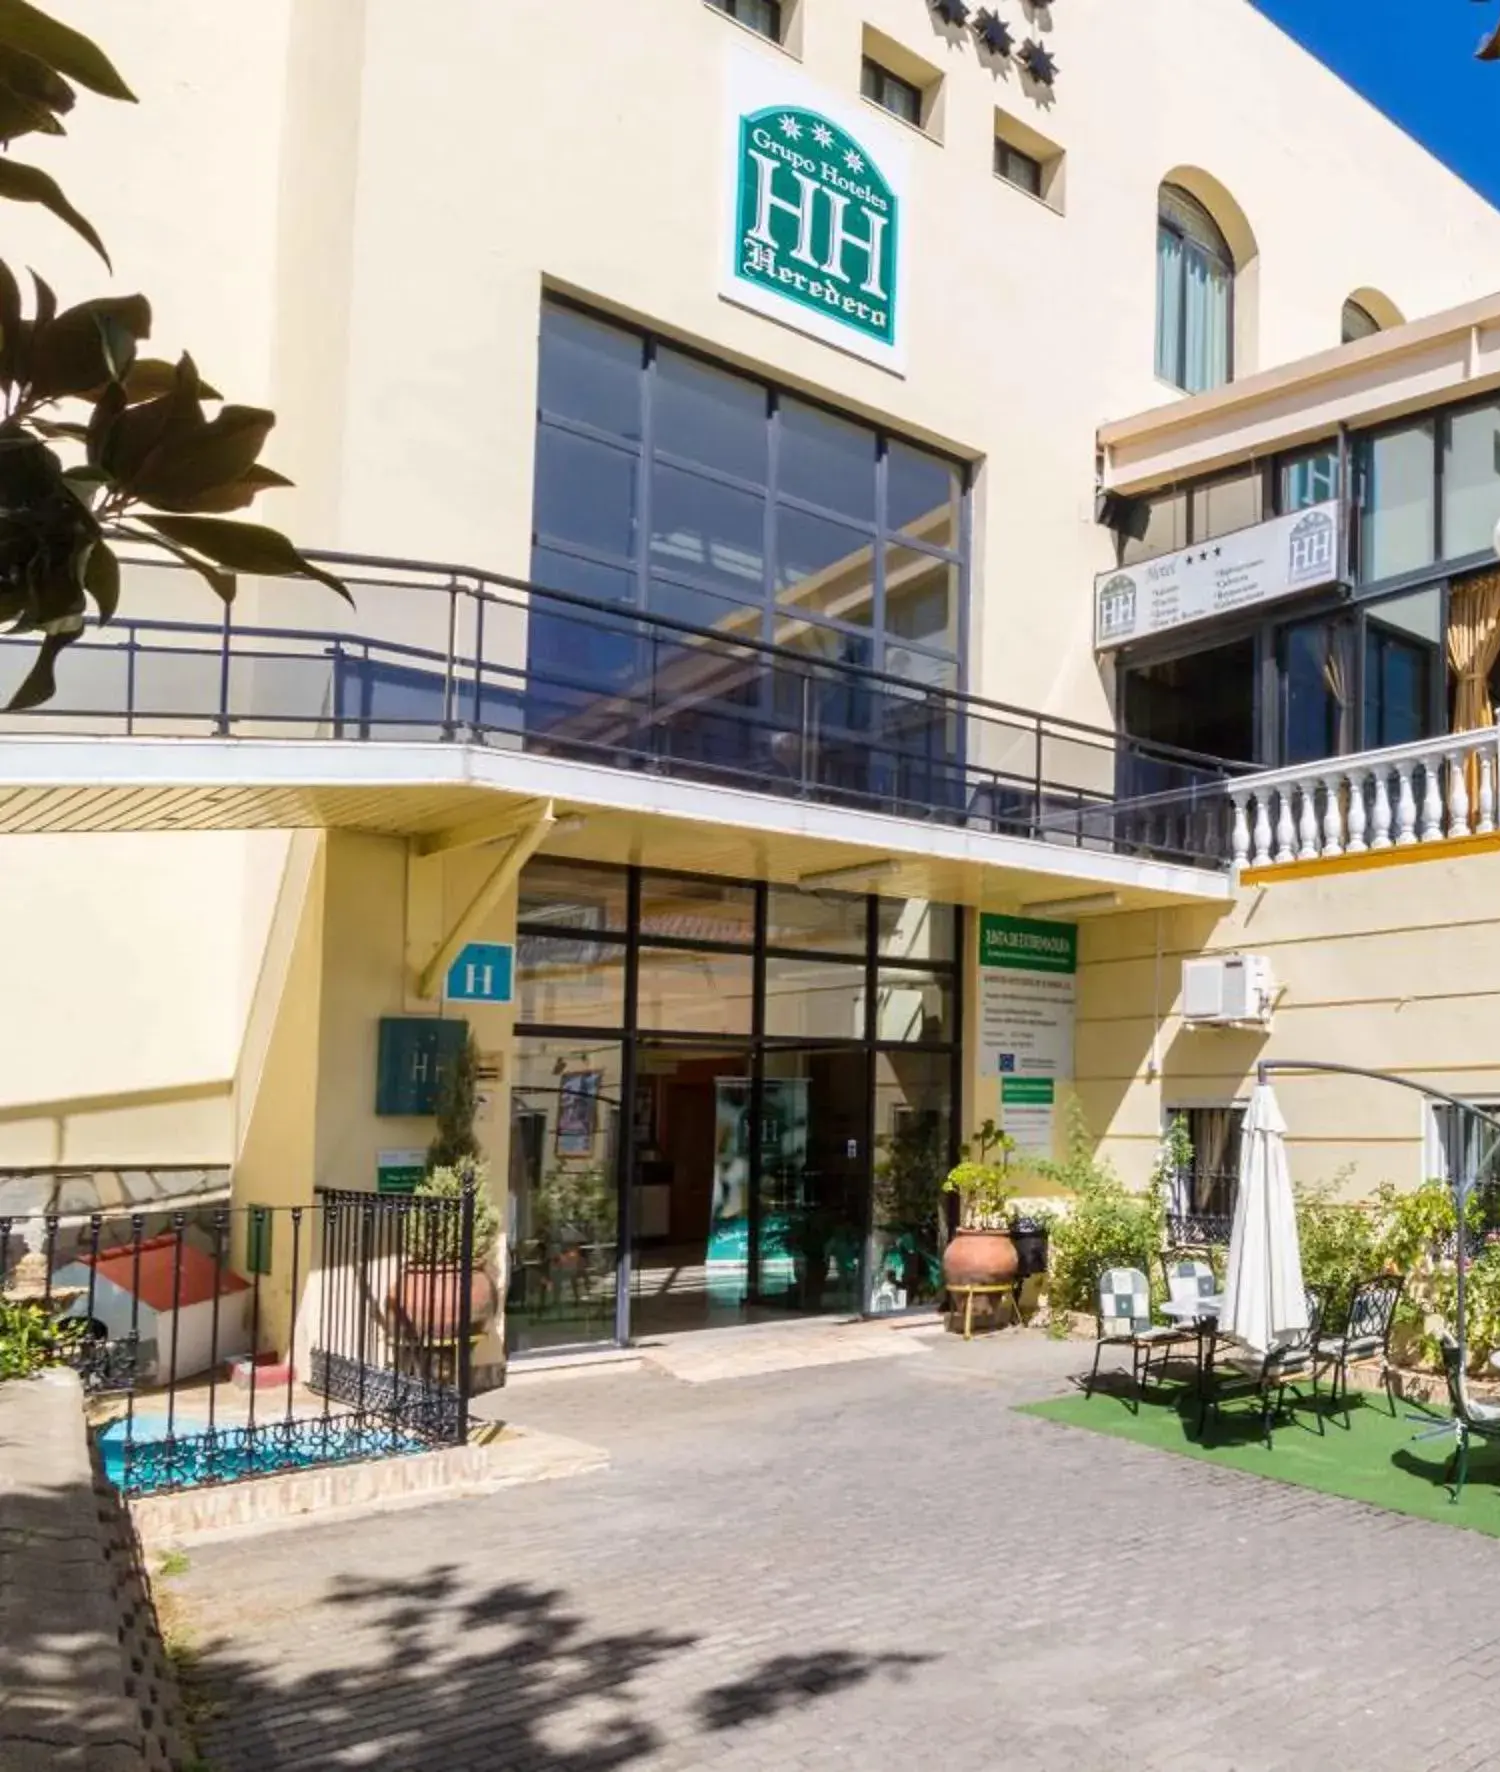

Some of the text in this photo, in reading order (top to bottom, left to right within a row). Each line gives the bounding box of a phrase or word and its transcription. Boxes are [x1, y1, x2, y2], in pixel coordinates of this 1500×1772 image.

[752, 128, 888, 211] Grupo Hoteles
[747, 149, 889, 301] HH
[1291, 530, 1330, 572] HH
[464, 963, 493, 996] H
